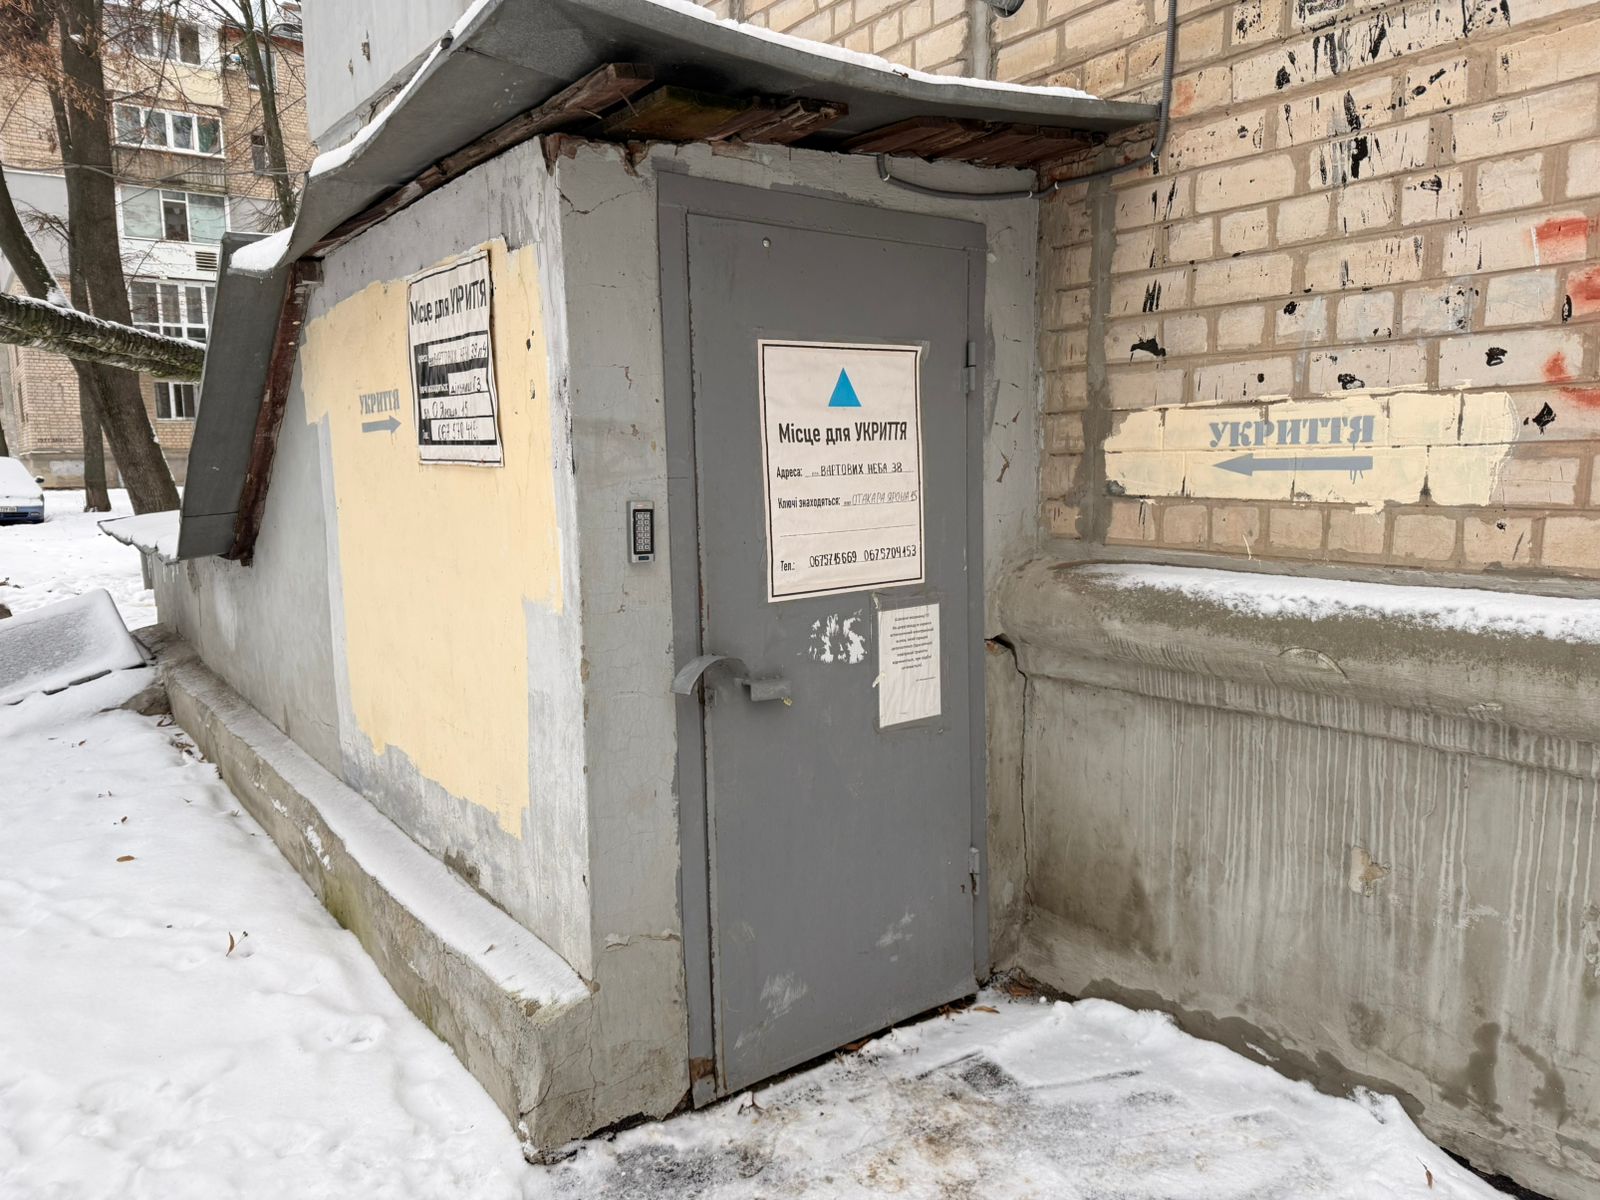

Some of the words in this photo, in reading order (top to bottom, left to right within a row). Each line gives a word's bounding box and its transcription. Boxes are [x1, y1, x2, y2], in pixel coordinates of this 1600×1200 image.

[359, 389, 400, 415] УКРИТТЯ
[778, 423, 821, 445] Місце
[826, 427, 851, 445] для
[854, 421, 908, 442] УКРИТТЯ
[1208, 415, 1376, 448] УКРИТТЯ
[776, 466, 803, 480] Адреса:
[778, 497, 798, 509] Ключі
[799, 497, 841, 509] знаходяться:
